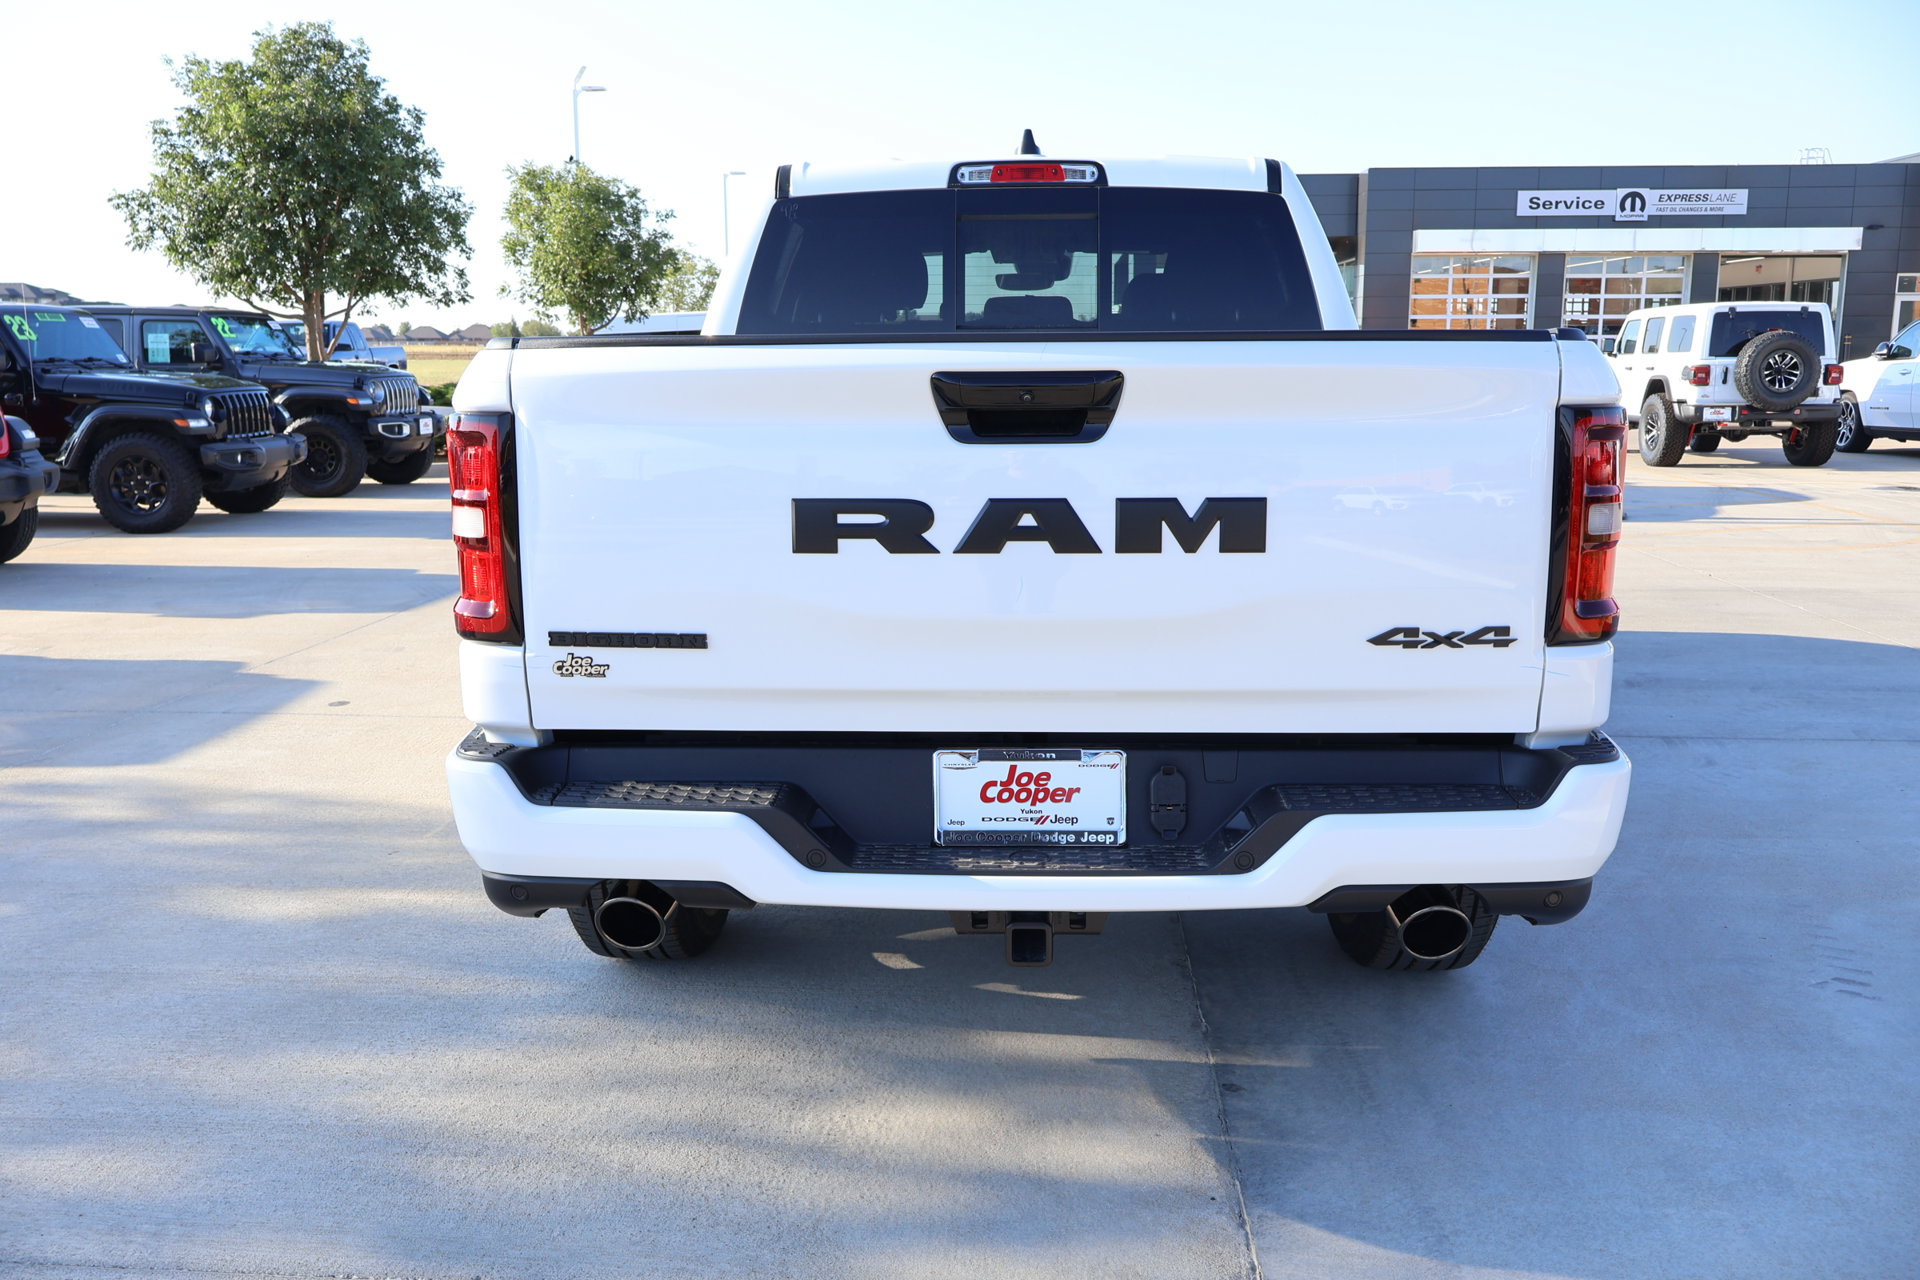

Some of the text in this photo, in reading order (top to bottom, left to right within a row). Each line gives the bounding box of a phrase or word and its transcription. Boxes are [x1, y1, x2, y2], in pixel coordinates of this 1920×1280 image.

[1528, 196, 1605, 210] Service
[3, 315, 37, 340] 23
[211, 317, 237, 338] 22
[791, 497, 1268, 554] RAM
[562, 653, 593, 666] Joe
[552, 661, 609, 676] Cooper
[1000, 764, 1051, 787] Joe
[979, 780, 1081, 806] Cooper
[947, 819, 965, 827] Jeep
[1050, 814, 1079, 826] Jeep
[945, 832, 1115, 845] Joe Cooper Dodge Jeep
